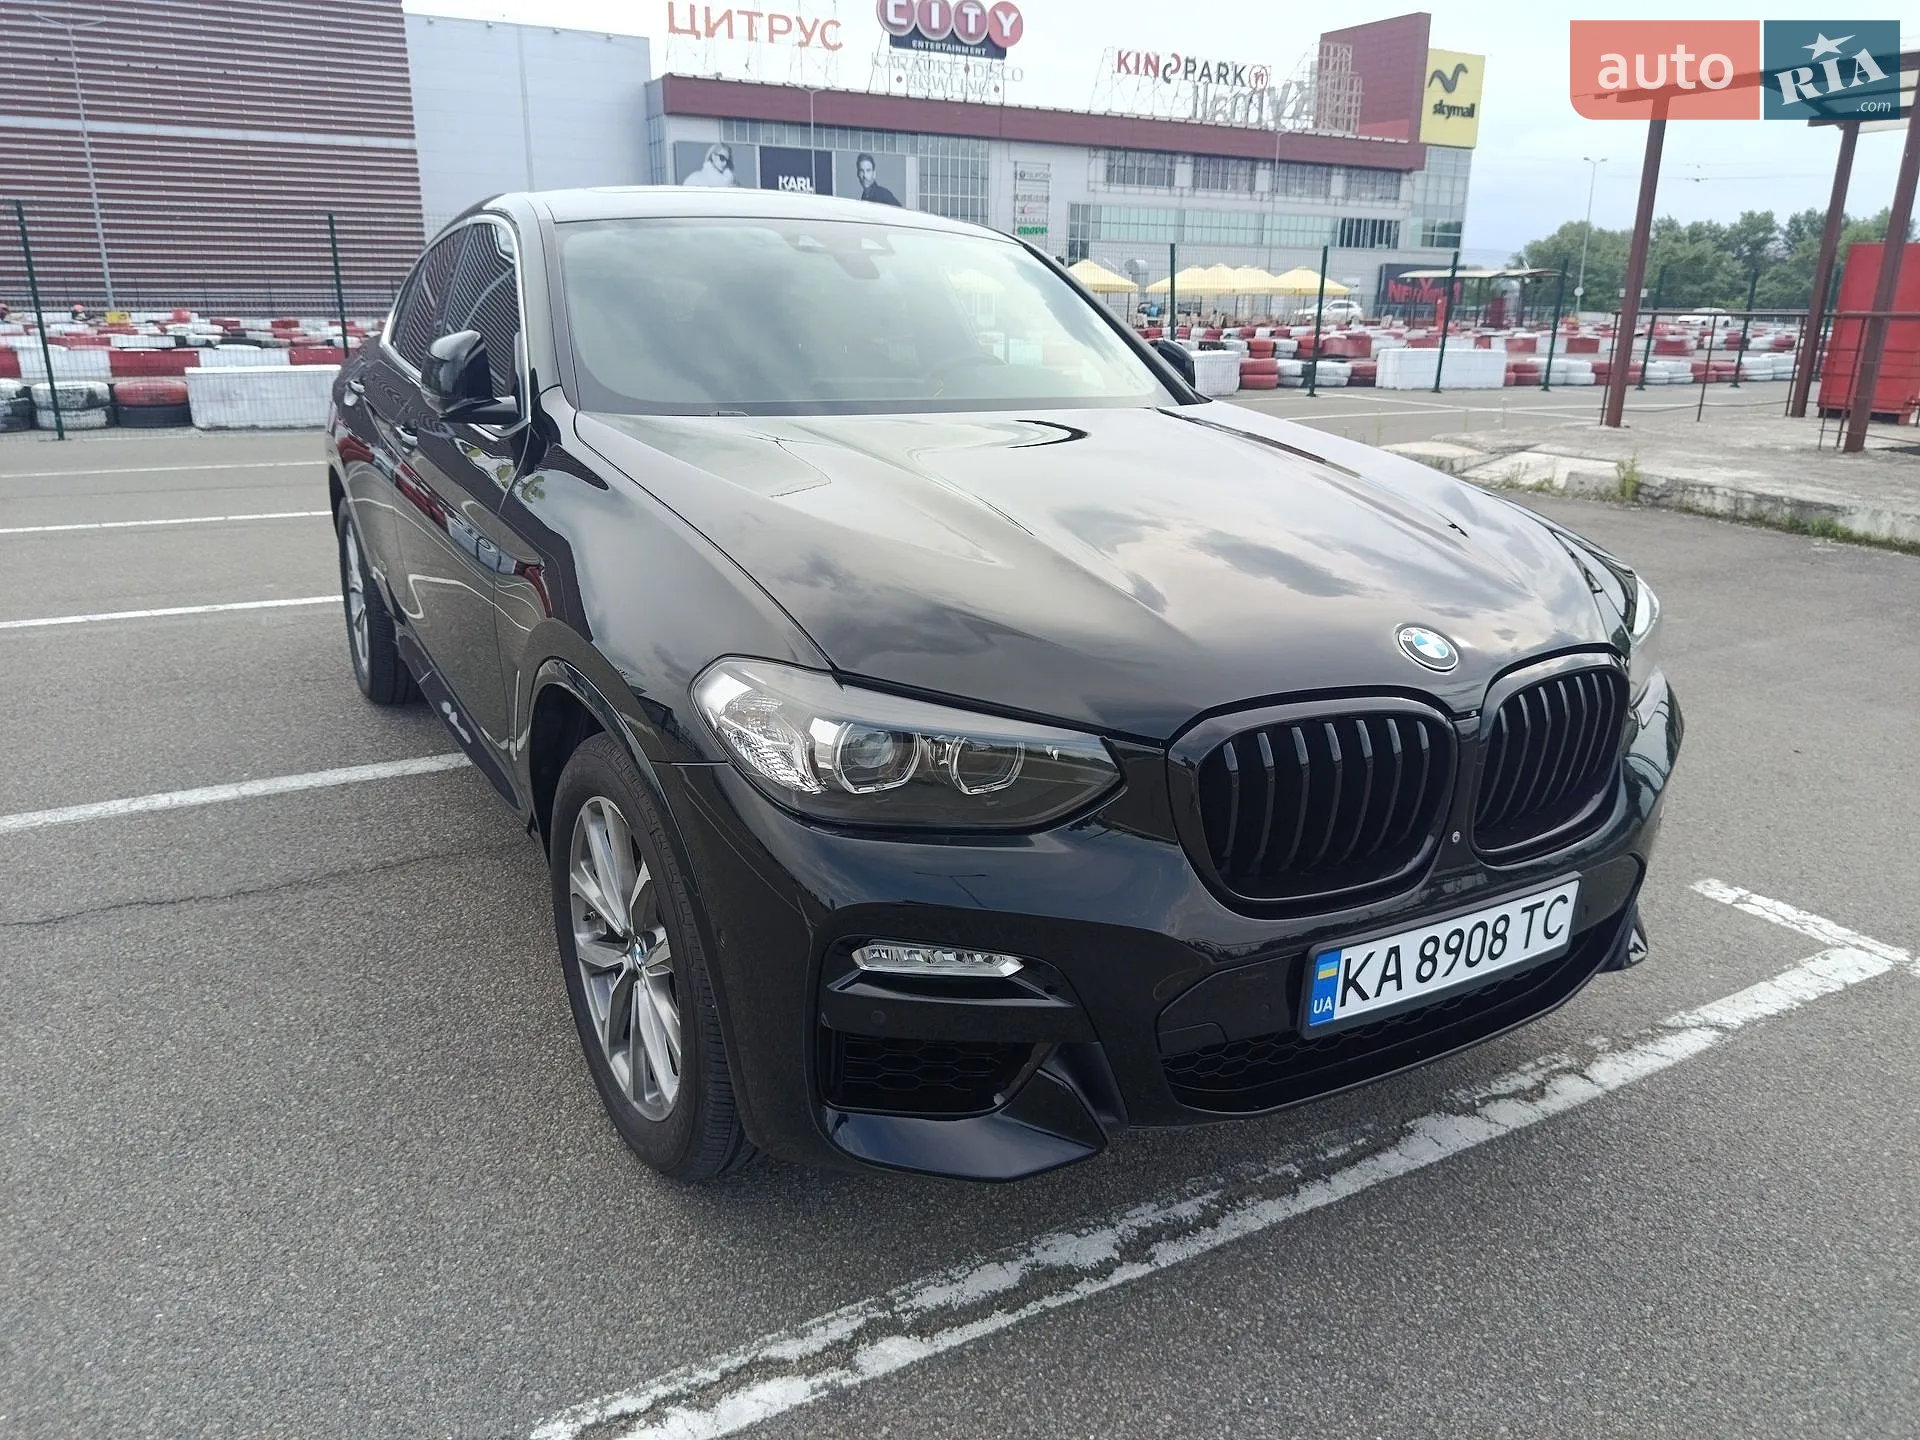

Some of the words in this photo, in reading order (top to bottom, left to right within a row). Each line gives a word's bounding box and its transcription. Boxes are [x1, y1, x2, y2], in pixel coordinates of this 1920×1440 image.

[668, 1, 843, 51] ЦИТРУС
[886, 0, 1019, 37] CITY
[911, 39, 986, 56] ENTERTAINMENT
[1433, 99, 1475, 119] skymall
[778, 175, 814, 192] KARL
[1339, 945, 1403, 1008] KA
[1415, 914, 1511, 984] 8908
[1521, 894, 1569, 949] TC
[1313, 996, 1333, 1014] UA
